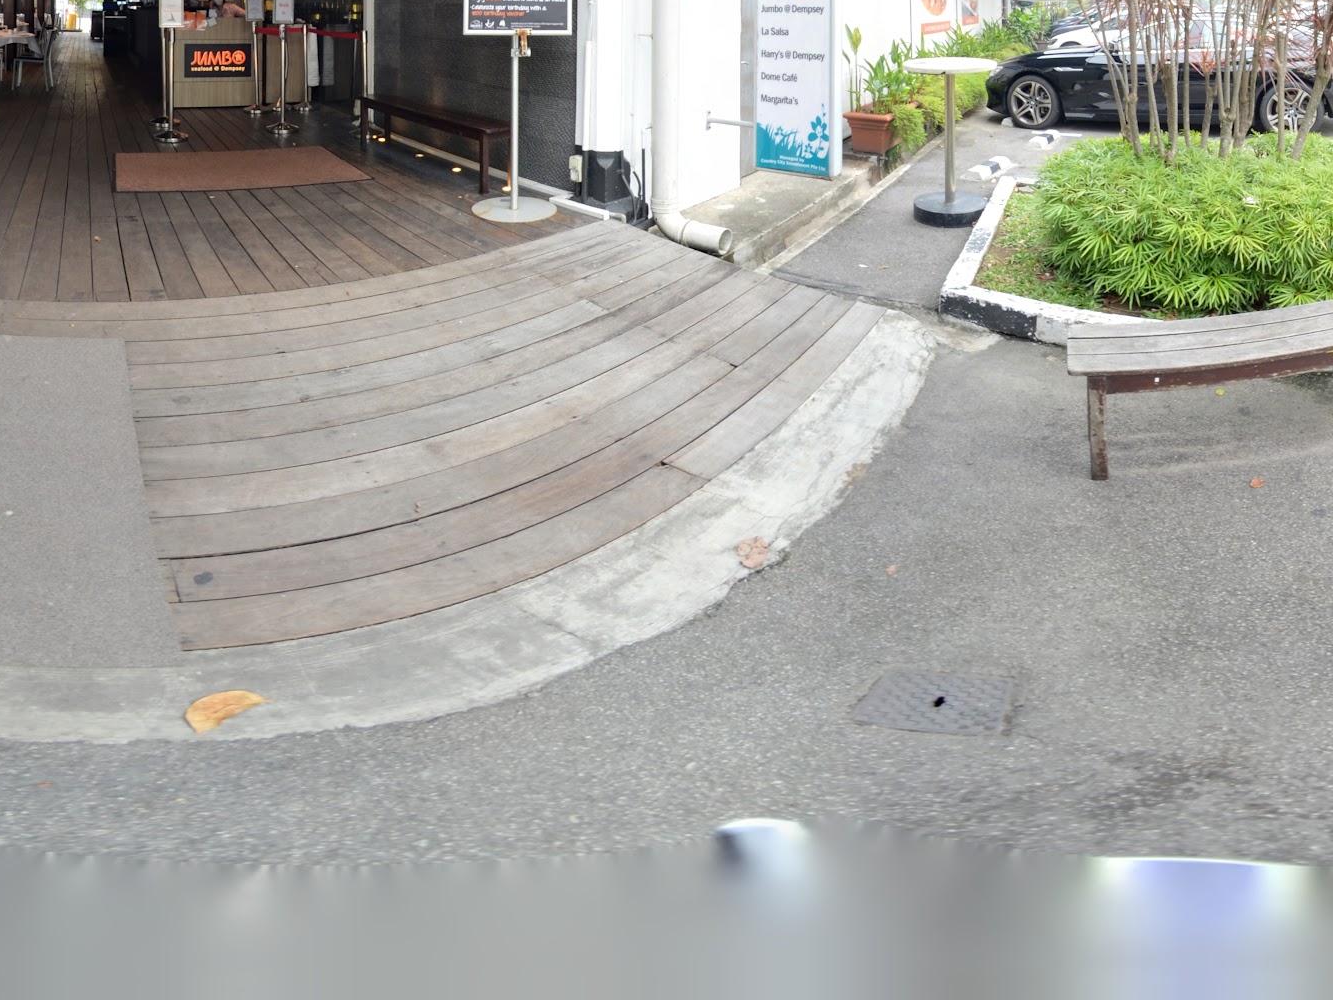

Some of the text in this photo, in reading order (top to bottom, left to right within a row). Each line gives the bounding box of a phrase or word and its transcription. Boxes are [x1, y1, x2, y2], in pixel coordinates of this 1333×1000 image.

[792, 5, 824, 14] Dempsey
[770, 27, 789, 36] Salsa
[191, 50, 246, 65] JUMBO
[761, 50, 825, 62] Harry's @ Dempsey
[761, 72, 798, 82] Dome Café
[761, 94, 798, 105] Margarita's
